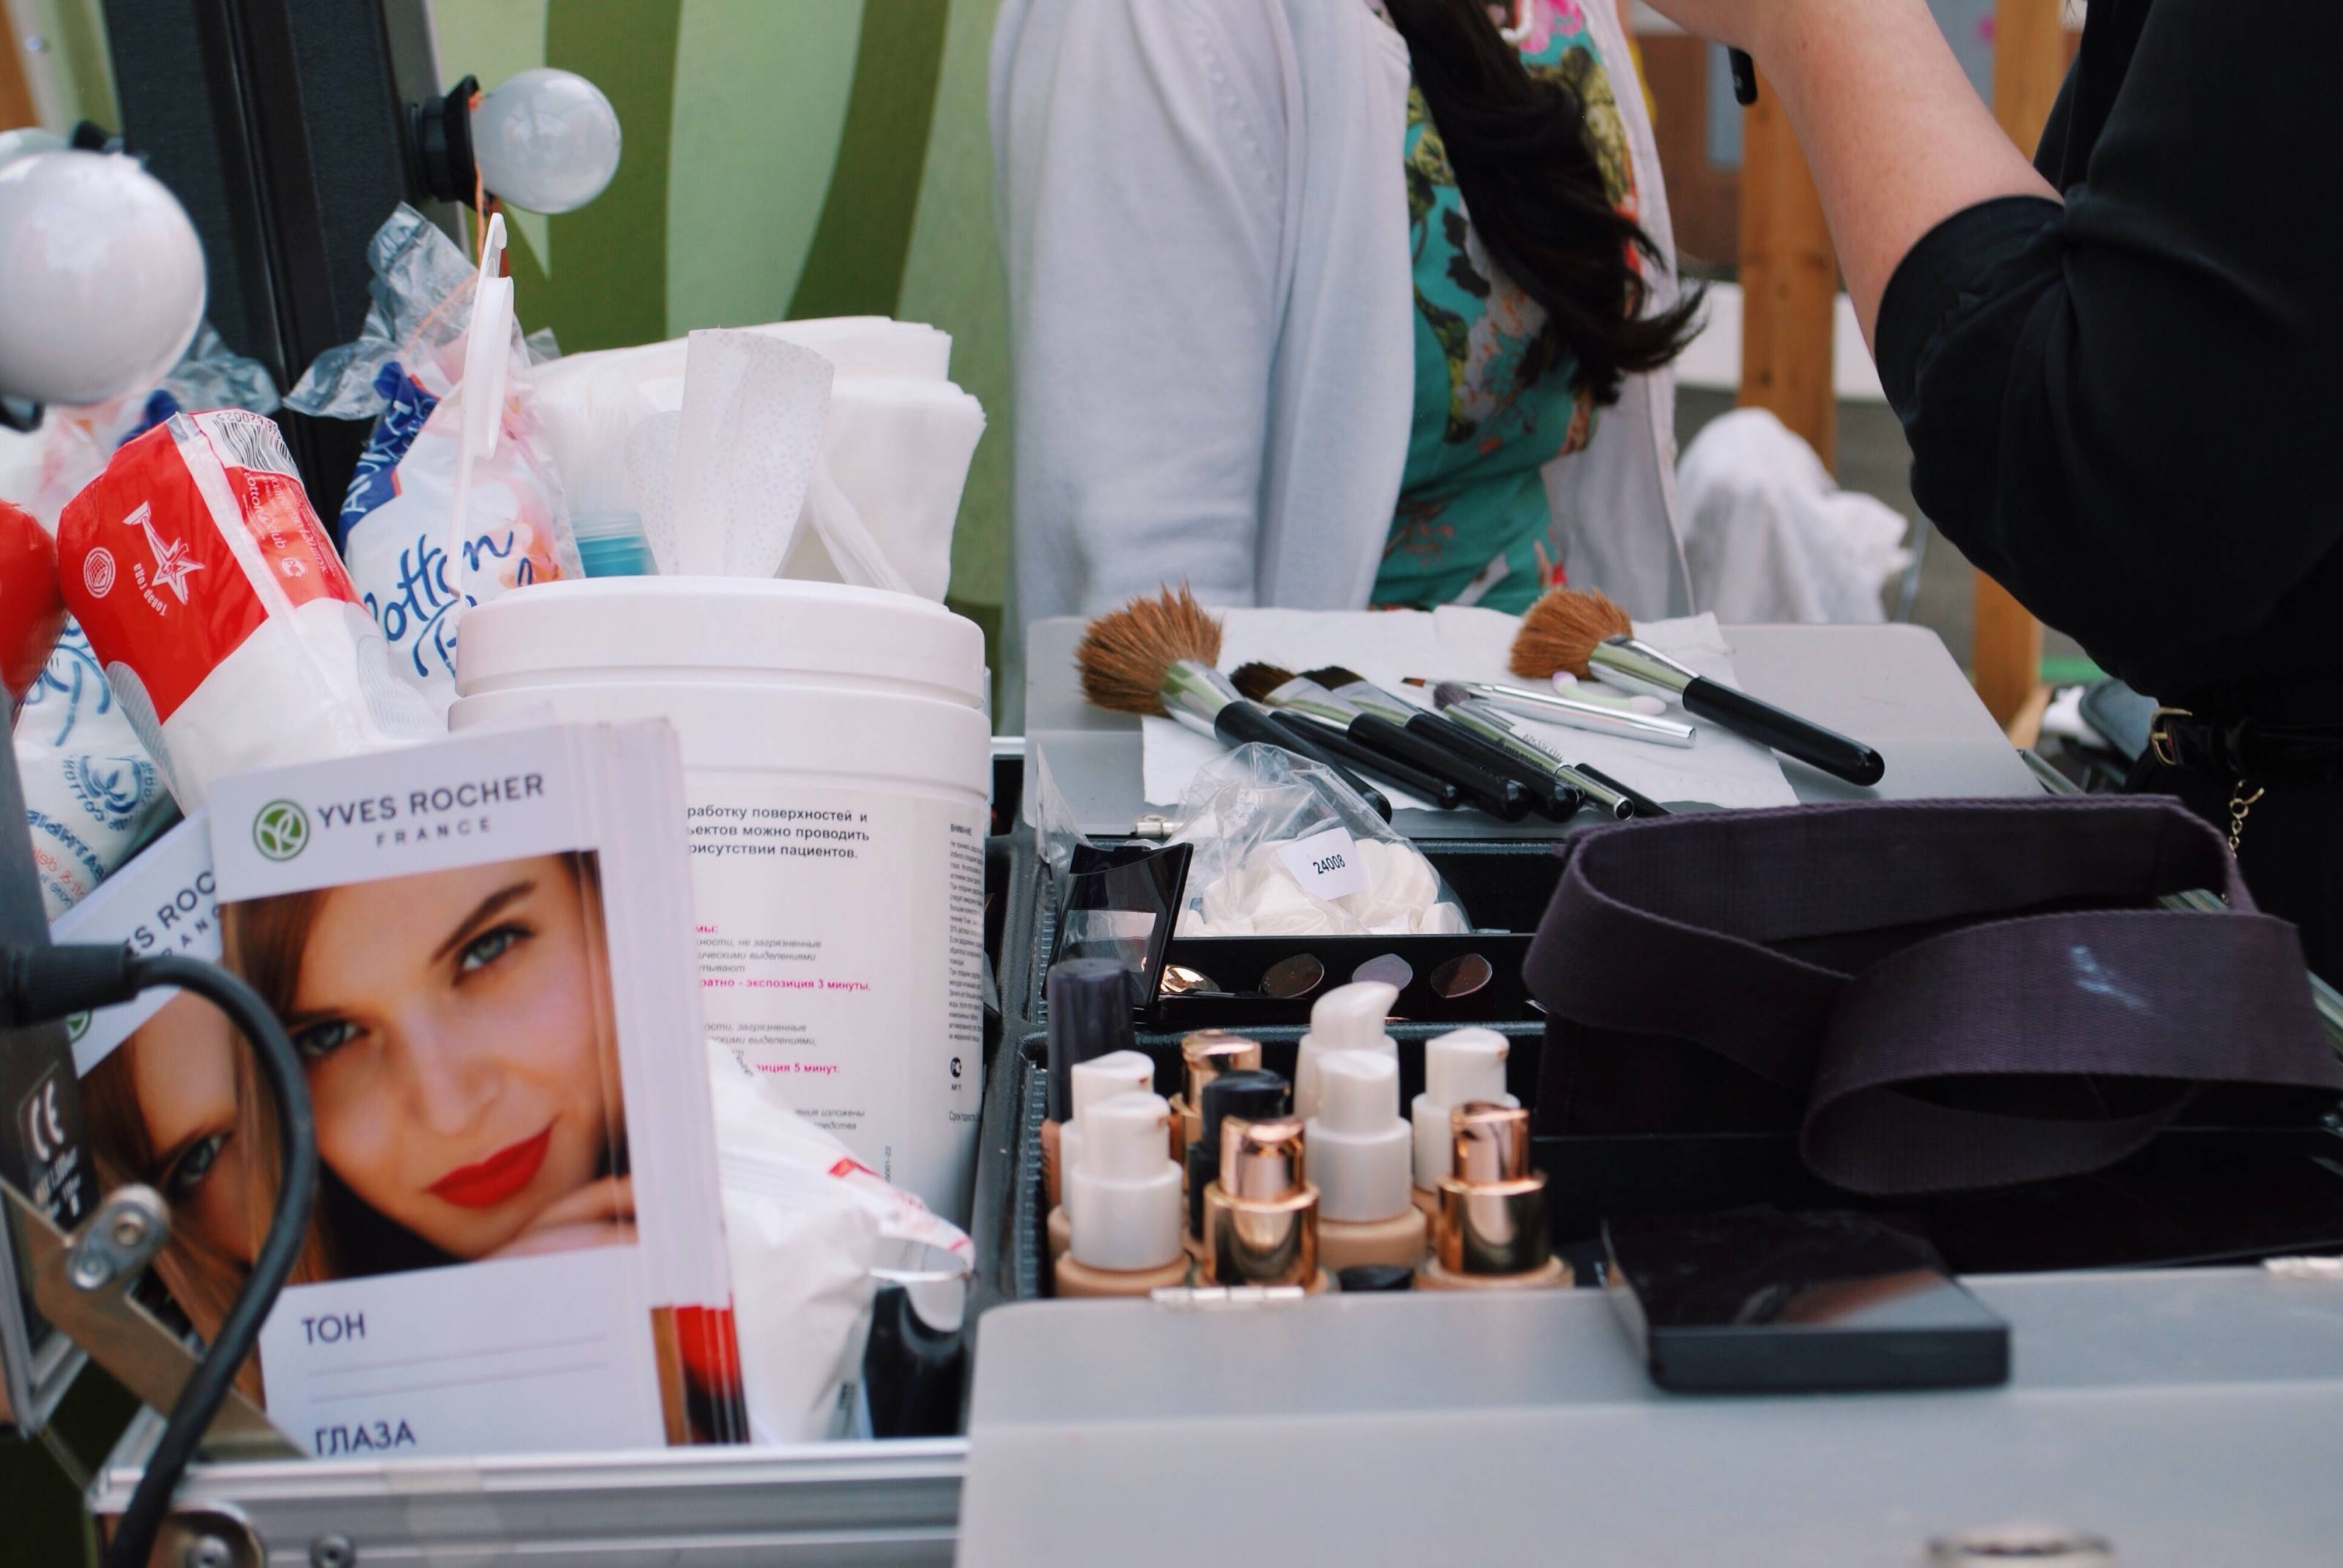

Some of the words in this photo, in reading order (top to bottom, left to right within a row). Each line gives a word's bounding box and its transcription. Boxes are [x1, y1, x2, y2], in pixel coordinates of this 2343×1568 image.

[143, 589, 168, 616] Товар
[318, 796, 398, 830] YVES
[409, 772, 545, 815] ROCHER
[752, 807, 852, 821] поверхностей
[860, 813, 868, 822] и
[376, 816, 491, 848] FRANCE
[742, 826, 791, 837] можно
[796, 828, 870, 841] проводить
[781, 845, 858, 859] пациентов.
[1313, 854, 1346, 875] 24008
[746, 979, 814, 990] экспозиция
[818, 979, 824, 989] 3
[827, 981, 871, 992] минуты.
[794, 1064, 800, 1073] 5
[804, 1064, 841, 1075] минут.
[301, 1313, 366, 1345] ТОН
[315, 1418, 416, 1457] ГЛАЗА
